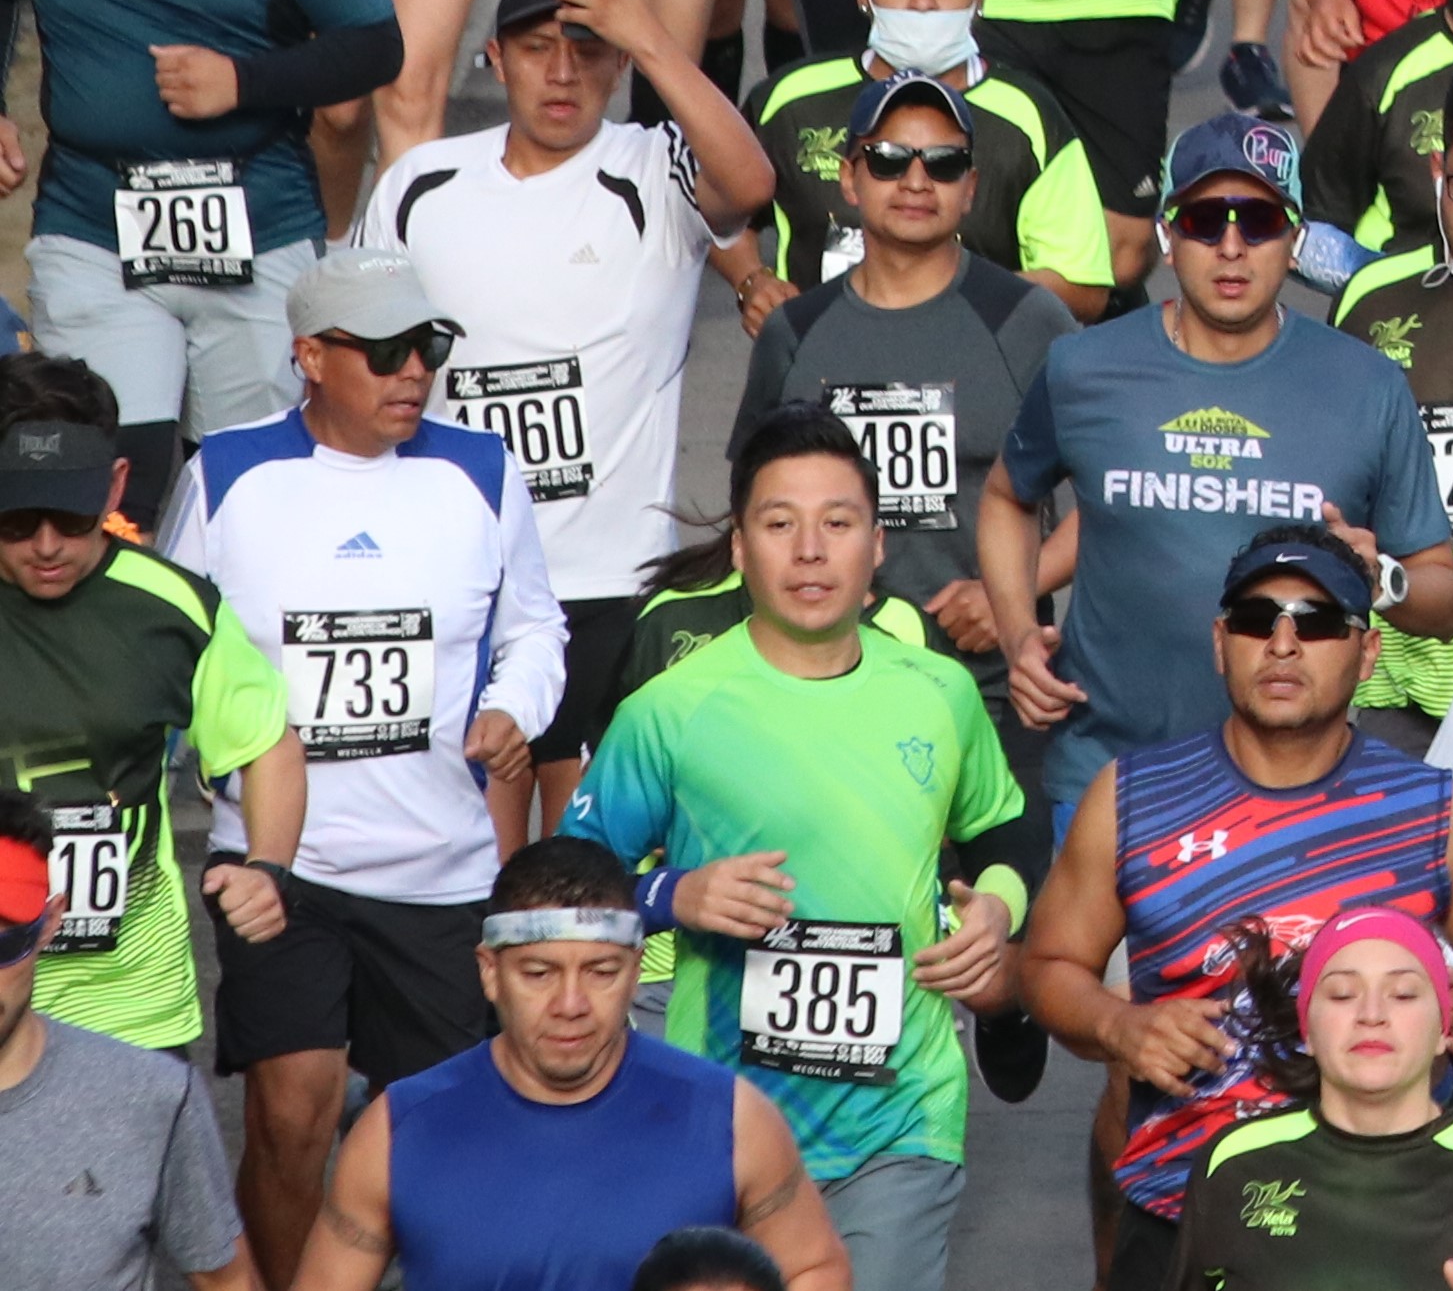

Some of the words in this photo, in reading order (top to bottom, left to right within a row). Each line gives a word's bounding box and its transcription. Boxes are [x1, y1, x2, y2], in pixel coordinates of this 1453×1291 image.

[142, 194, 227, 256] 269
[1164, 433, 1264, 459] ULTRA
[1190, 454, 1232, 471] 50K
[1103, 469, 1325, 520] FINISHER
[306, 647, 410, 721] 733
[336, 746, 382, 758] MEDALLA
[60, 839, 120, 913] 16
[767, 959, 879, 1037] 385
[791, 1064, 842, 1078] MEDALLA
[1263, 1210, 1294, 1225] Xela
